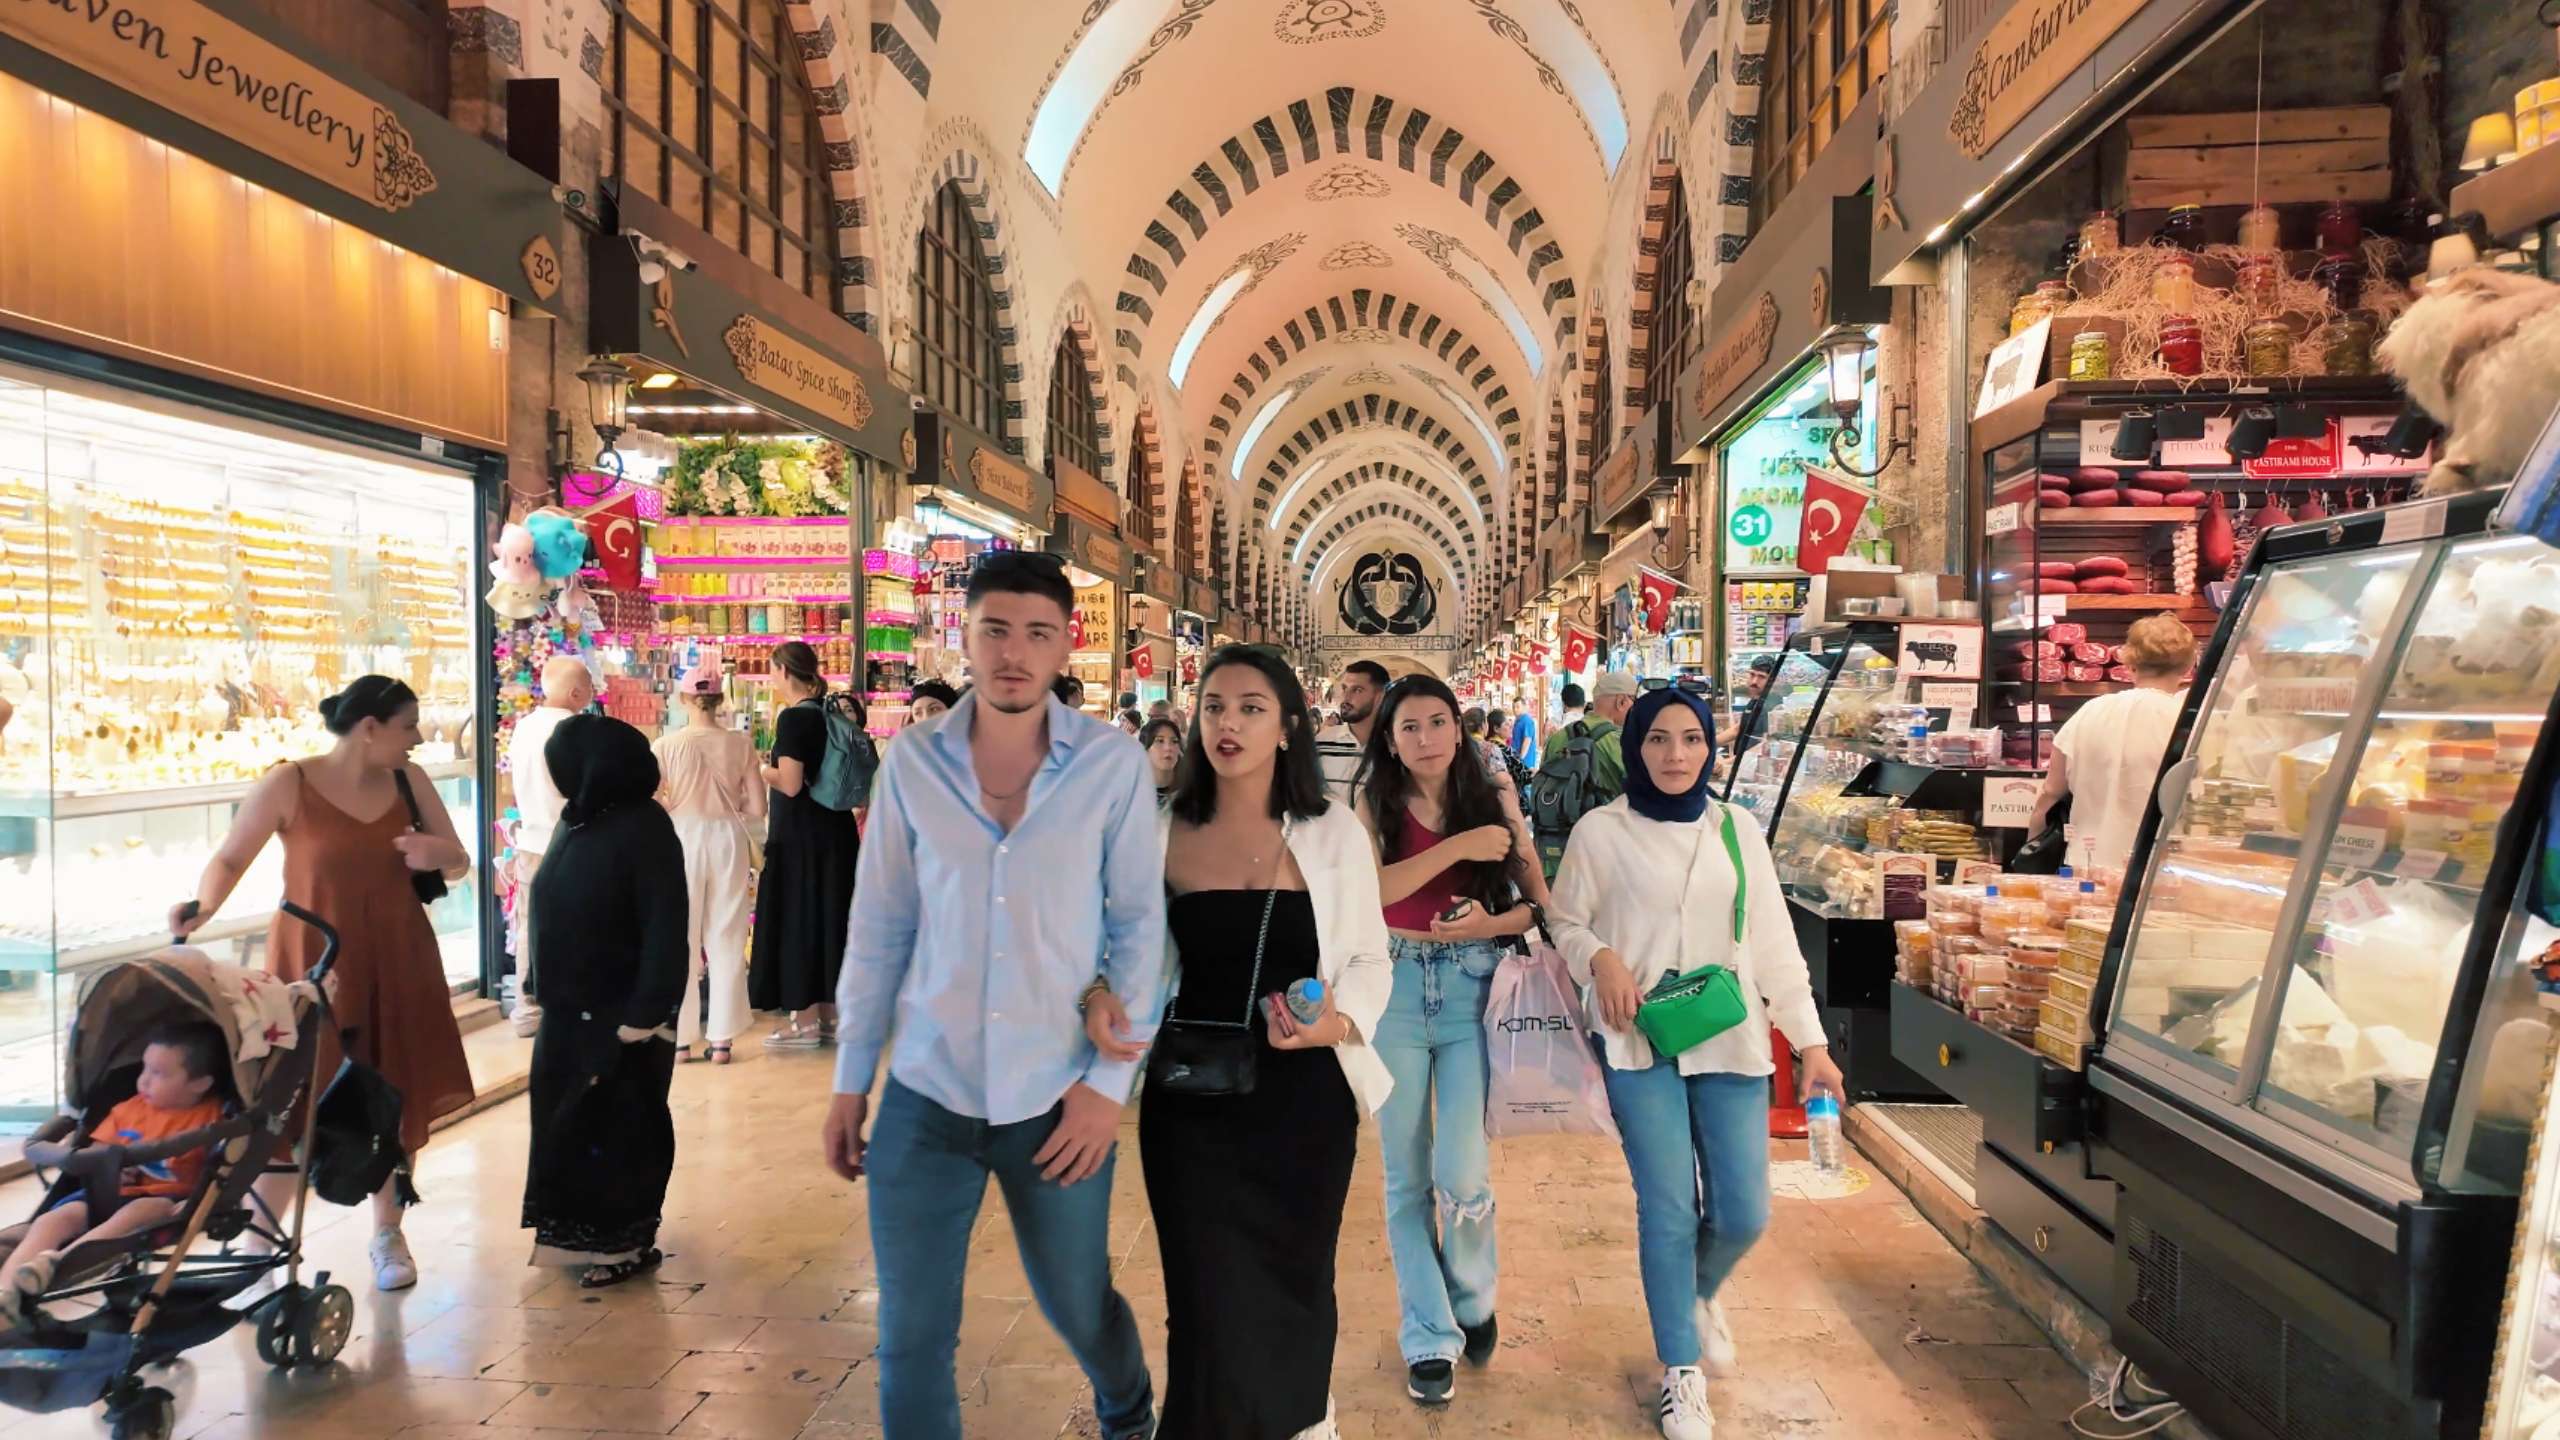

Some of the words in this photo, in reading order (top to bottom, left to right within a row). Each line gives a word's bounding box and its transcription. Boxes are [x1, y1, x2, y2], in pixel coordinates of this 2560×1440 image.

[178, 36, 365, 168] Jewellery
[533, 251, 555, 286] 32
[1812, 282, 1821, 312] 31
[758, 340, 793, 377] Batas
[795, 360, 824, 391] Spice
[827, 374, 852, 411] Shop
[1809, 427, 1836, 444] SP
[2303, 455, 2331, 466] HOUSE
[1734, 514, 1767, 536] 31
[1750, 546, 1798, 565] MOU
